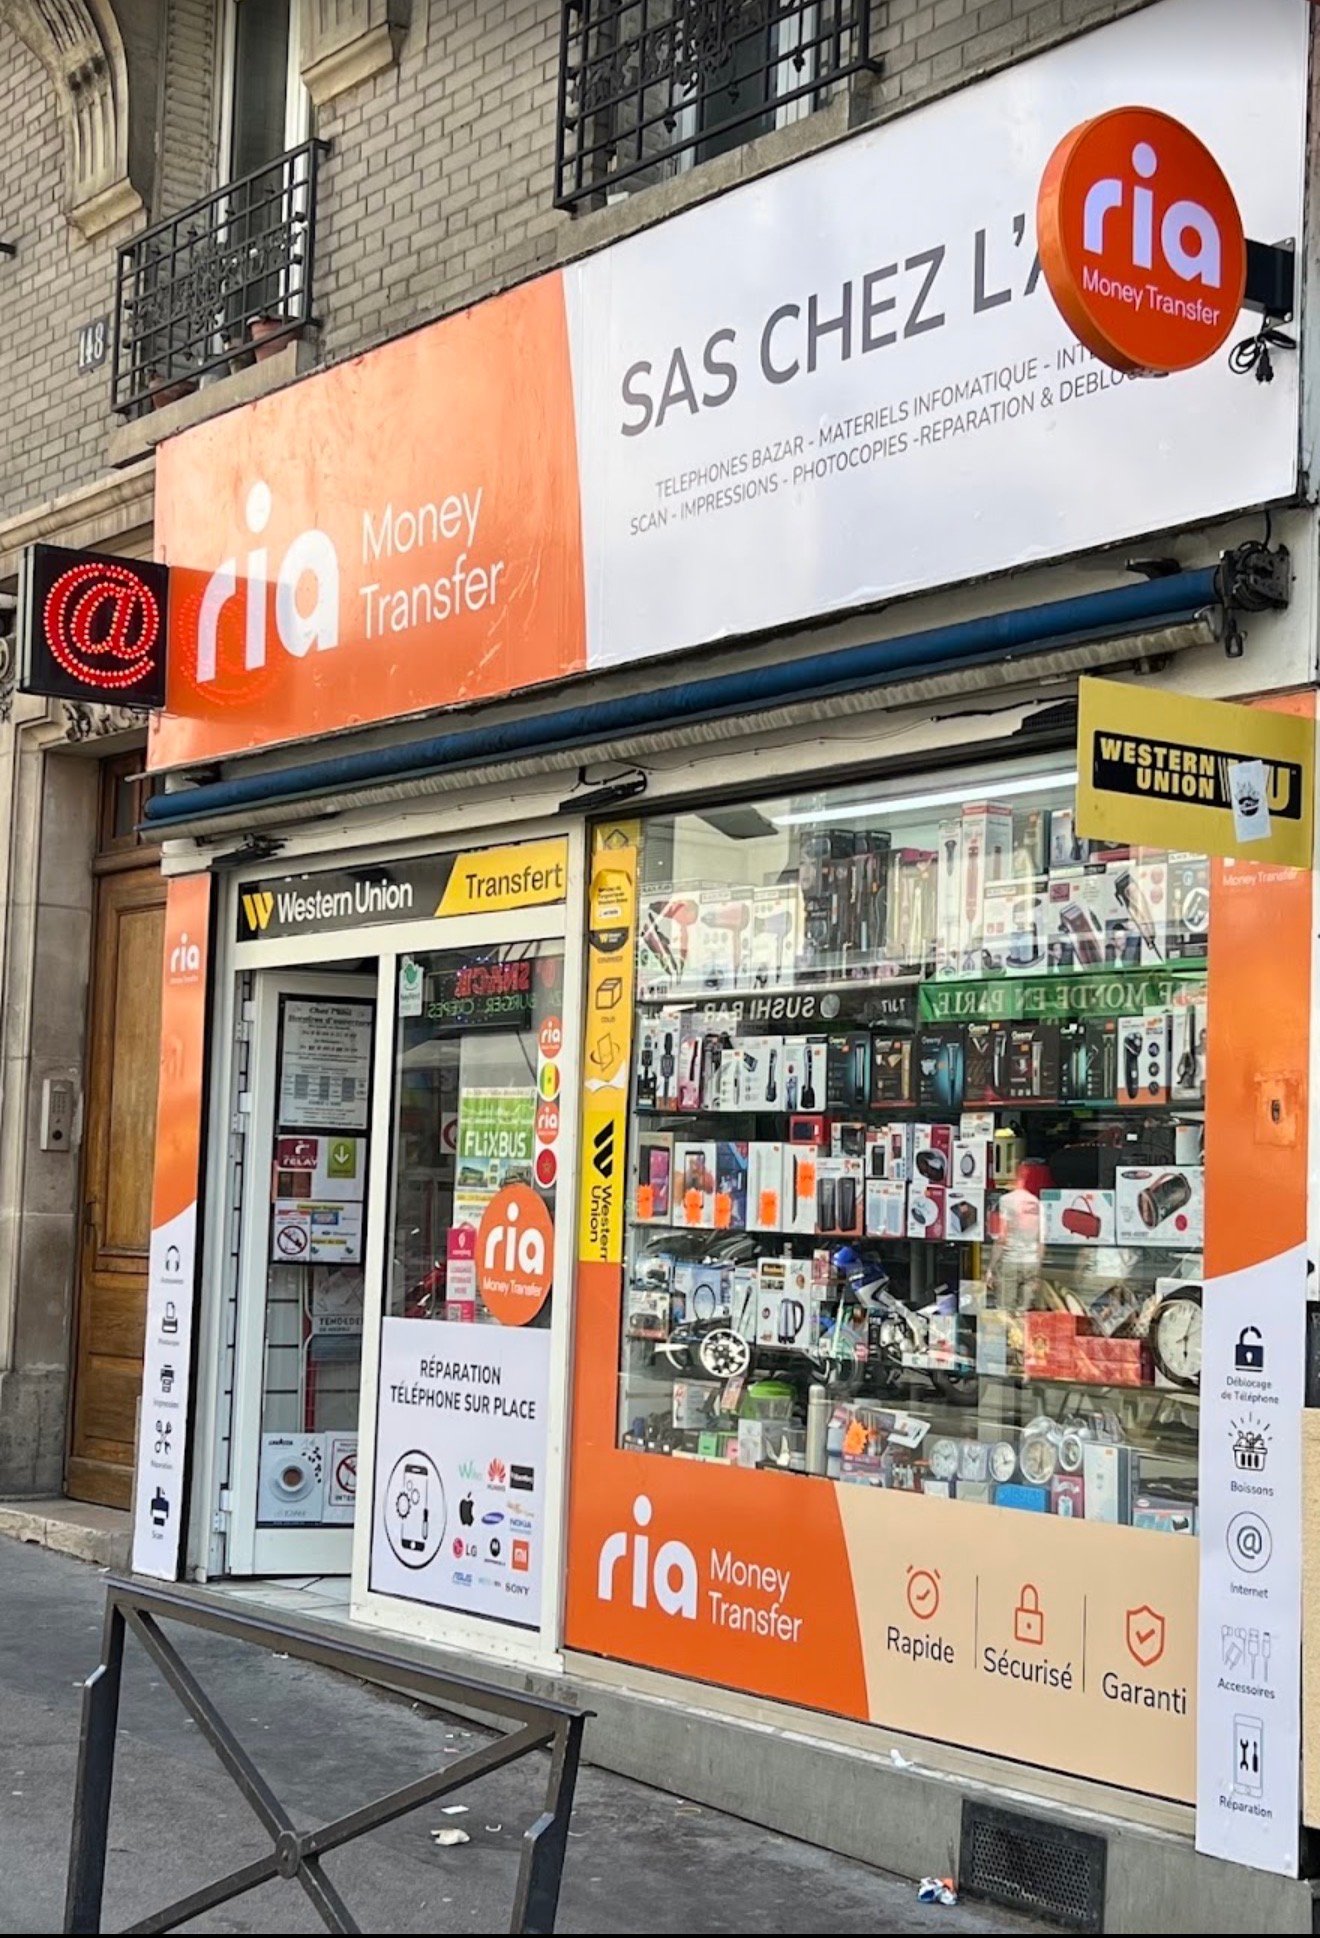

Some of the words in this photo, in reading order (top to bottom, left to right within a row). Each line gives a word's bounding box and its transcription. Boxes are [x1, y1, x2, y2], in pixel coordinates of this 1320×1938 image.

[1083, 142, 1221, 289] ria
[1082, 265, 1144, 312] Money
[1145, 284, 1221, 327] Transfer
[79, 321, 105, 368] 148
[620, 327, 738, 437] SAS
[760, 243, 945, 384] CHEZ
[973, 212, 1043, 314] L'
[655, 453, 748, 499] TELEPHONES
[752, 435, 804, 470] BAZAR
[819, 400, 909, 448] MATERIELS
[913, 357, 1038, 418] INFOMATIQUE
[1057, 342, 1098, 371] INT
[630, 509, 668, 536] SCAN
[680, 473, 779, 521] IMPRESSIONS
[793, 432, 908, 486] PHOTOCOPIES
[1040, 386, 1054, 408] &
[361, 485, 484, 566] Money
[195, 480, 341, 684] ria
[359, 553, 505, 640] Transfer
[1100, 737, 1215, 777] WESTERN
[1136, 767, 1215, 800] UNION
[465, 862, 563, 899] Transfert
[277, 889, 353, 924] Western
[355, 881, 413, 914] Union
[170, 932, 200, 973] ria
[541, 1020, 561, 1044] ria
[538, 1106, 558, 1129] ria
[590, 1185, 602, 1242] Union
[484, 1201, 545, 1275] ria
[482, 1275, 510, 1297] Money
[420, 1354, 501, 1386] RÉPARATION
[1226, 1375, 1273, 1390] Déblocage
[390, 1380, 461, 1410] TÉLÉPHONE
[465, 1393, 490, 1415] SUR
[494, 1396, 536, 1420] PLACE
[1221, 1391, 1233, 1401] de
[1235, 1391, 1280, 1405] Téléphone
[1230, 1480, 1275, 1498] Boissons
[597, 1493, 698, 1620] ria
[710, 1547, 791, 1597] Money
[1230, 1582, 1269, 1599] Internet
[708, 1591, 803, 1643] Transfer
[886, 1625, 955, 1664] Rapide
[983, 1646, 1074, 1690] Sécurisé
[1217, 1677, 1276, 1700] Accessoires
[1102, 1671, 1188, 1715] Garanti
[1218, 1795, 1273, 1820] Réparation
